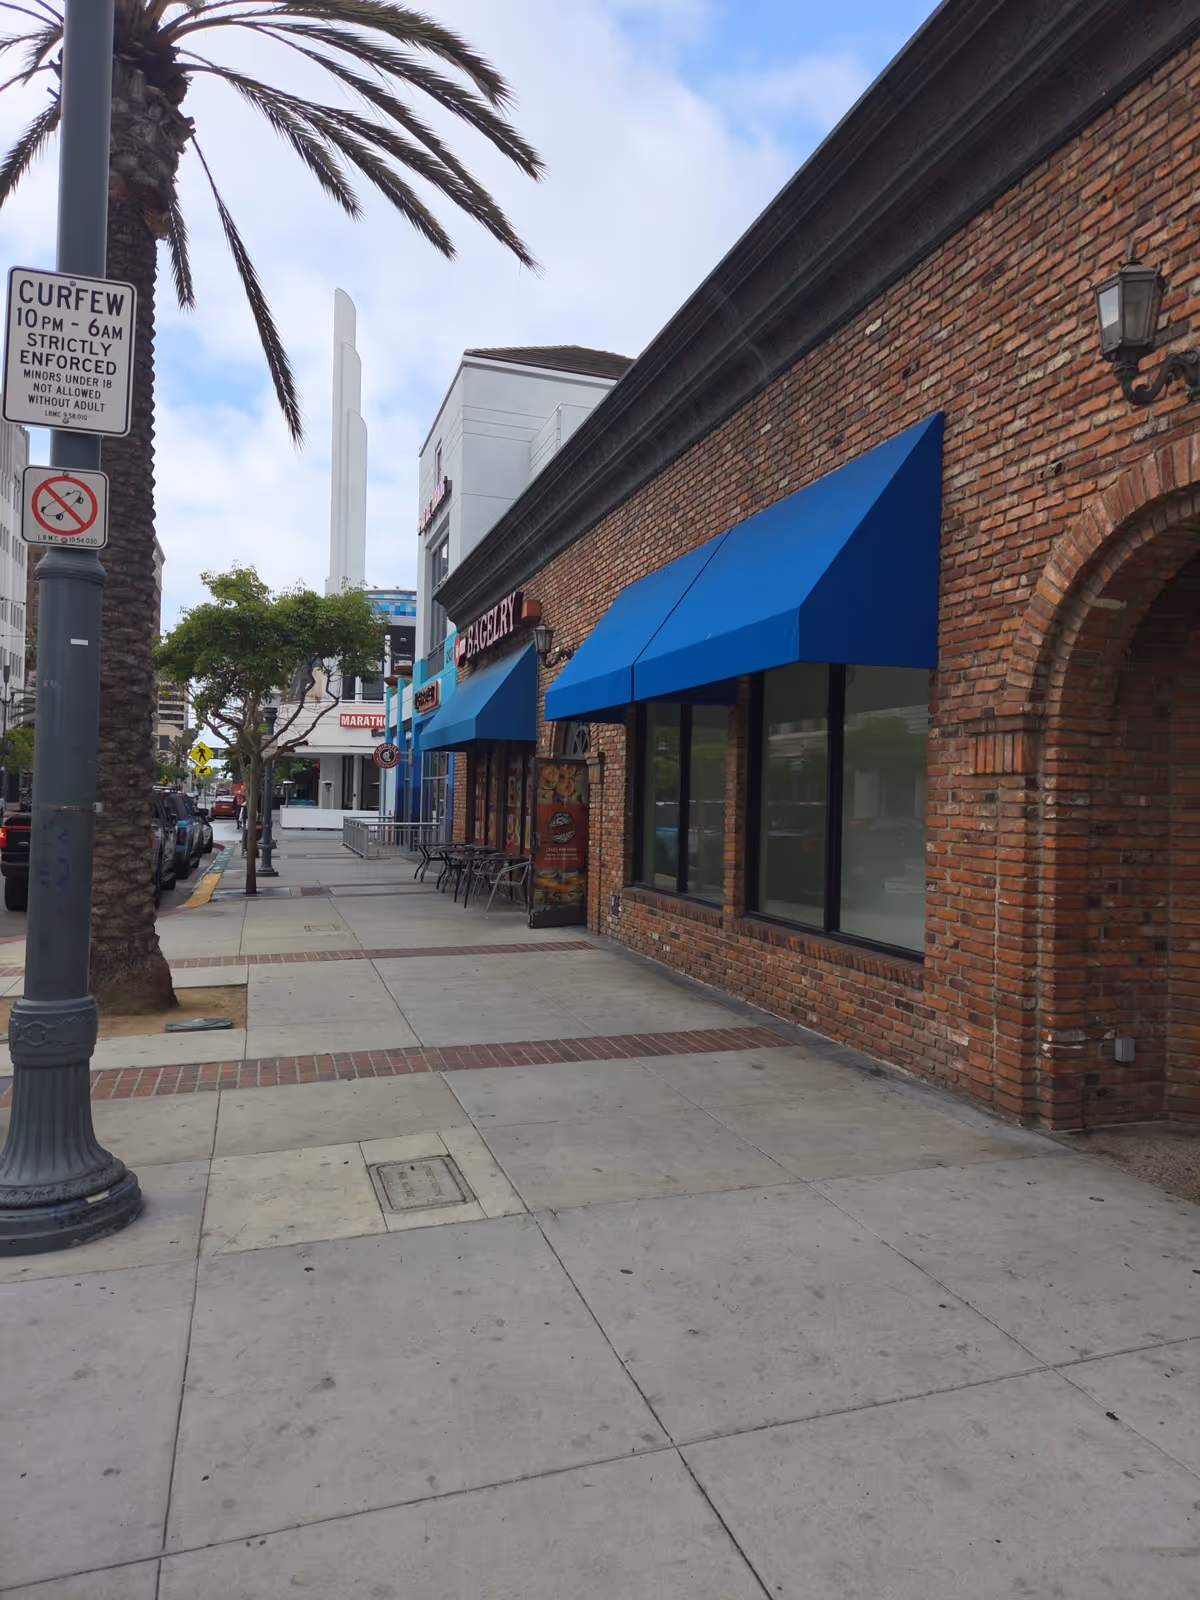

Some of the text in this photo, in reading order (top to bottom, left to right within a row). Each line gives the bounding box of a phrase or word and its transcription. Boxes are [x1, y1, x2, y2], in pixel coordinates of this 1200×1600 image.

[19, 280, 125, 317] CURFEW
[27, 333, 112, 357] STRICTLY
[20, 350, 117, 376] ENFORCED
[23, 369, 112, 389] MINORS UNDER 18
[33, 382, 101, 400] NOT ALLOWED
[28, 394, 105, 413] WITHOUT ADULT
[466, 592, 516, 659] BAGELRY
[341, 715, 386, 727] MARATH
